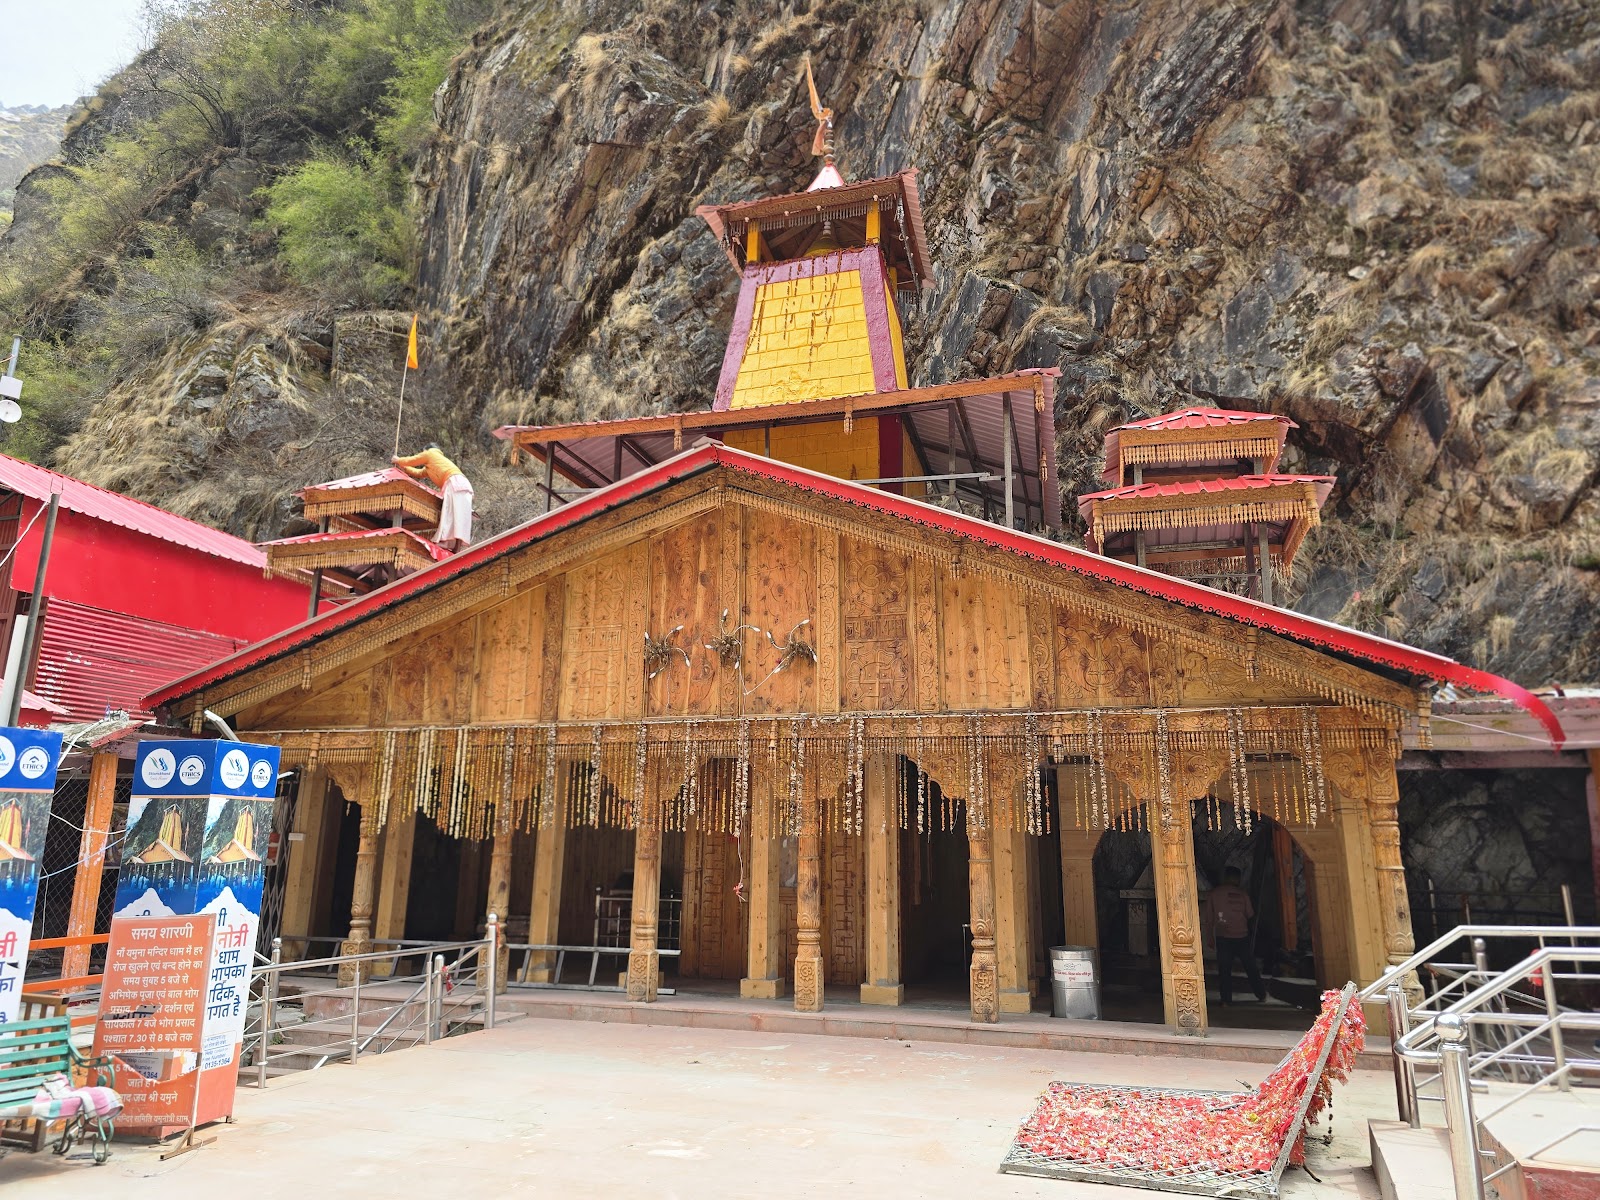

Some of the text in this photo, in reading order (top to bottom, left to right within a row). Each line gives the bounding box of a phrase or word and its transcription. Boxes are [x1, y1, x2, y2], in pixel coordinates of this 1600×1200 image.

[131, 927, 157, 940] समय
[160, 922, 194, 939] शारणी
[126, 948, 146, 960] यमुना
[147, 945, 168, 957] मन्दिर
[169, 946, 184, 956] धाम
[185, 944, 193, 955] में
[193, 946, 203, 956] हर
[218, 949, 240, 964] धाम
[112, 961, 127, 972] रोज
[128, 961, 149, 974] खुलने
[150, 960, 161, 972] एवं
[178, 959, 192, 971] होने
[193, 960, 203, 970] का
[123, 976, 141, 986] समय
[160, 976, 167, 984] 5
[181, 973, 189, 984] से
[108, 989, 138, 1000] अभिषेक
[139, 990, 155, 1001] पूजा
[156, 988, 167, 1000] एवं
[184, 987, 199, 998] भोग
[164, 1001, 182, 1013] दर्शन
[183, 1002, 195, 1014] एवं
[232, 994, 241, 1016] है
[137, 1020, 143, 1028] 7
[143, 1017, 157, 1028] बजे
[158, 1017, 174, 1027] भोग
[175, 1018, 196, 1028] प्रसाद
[103, 1034, 127, 1044] पश्चात
[128, 1034, 147, 1042] 7.30
[149, 1031, 156, 1042] से
[157, 1034, 163, 1042] 8
[165, 1031, 178, 1042] बजे
[179, 1033, 193, 1042] तक
[133, 1093, 147, 1102] जय
[149, 1091, 158, 1102] श्री
[160, 1091, 178, 1105] यमुने
